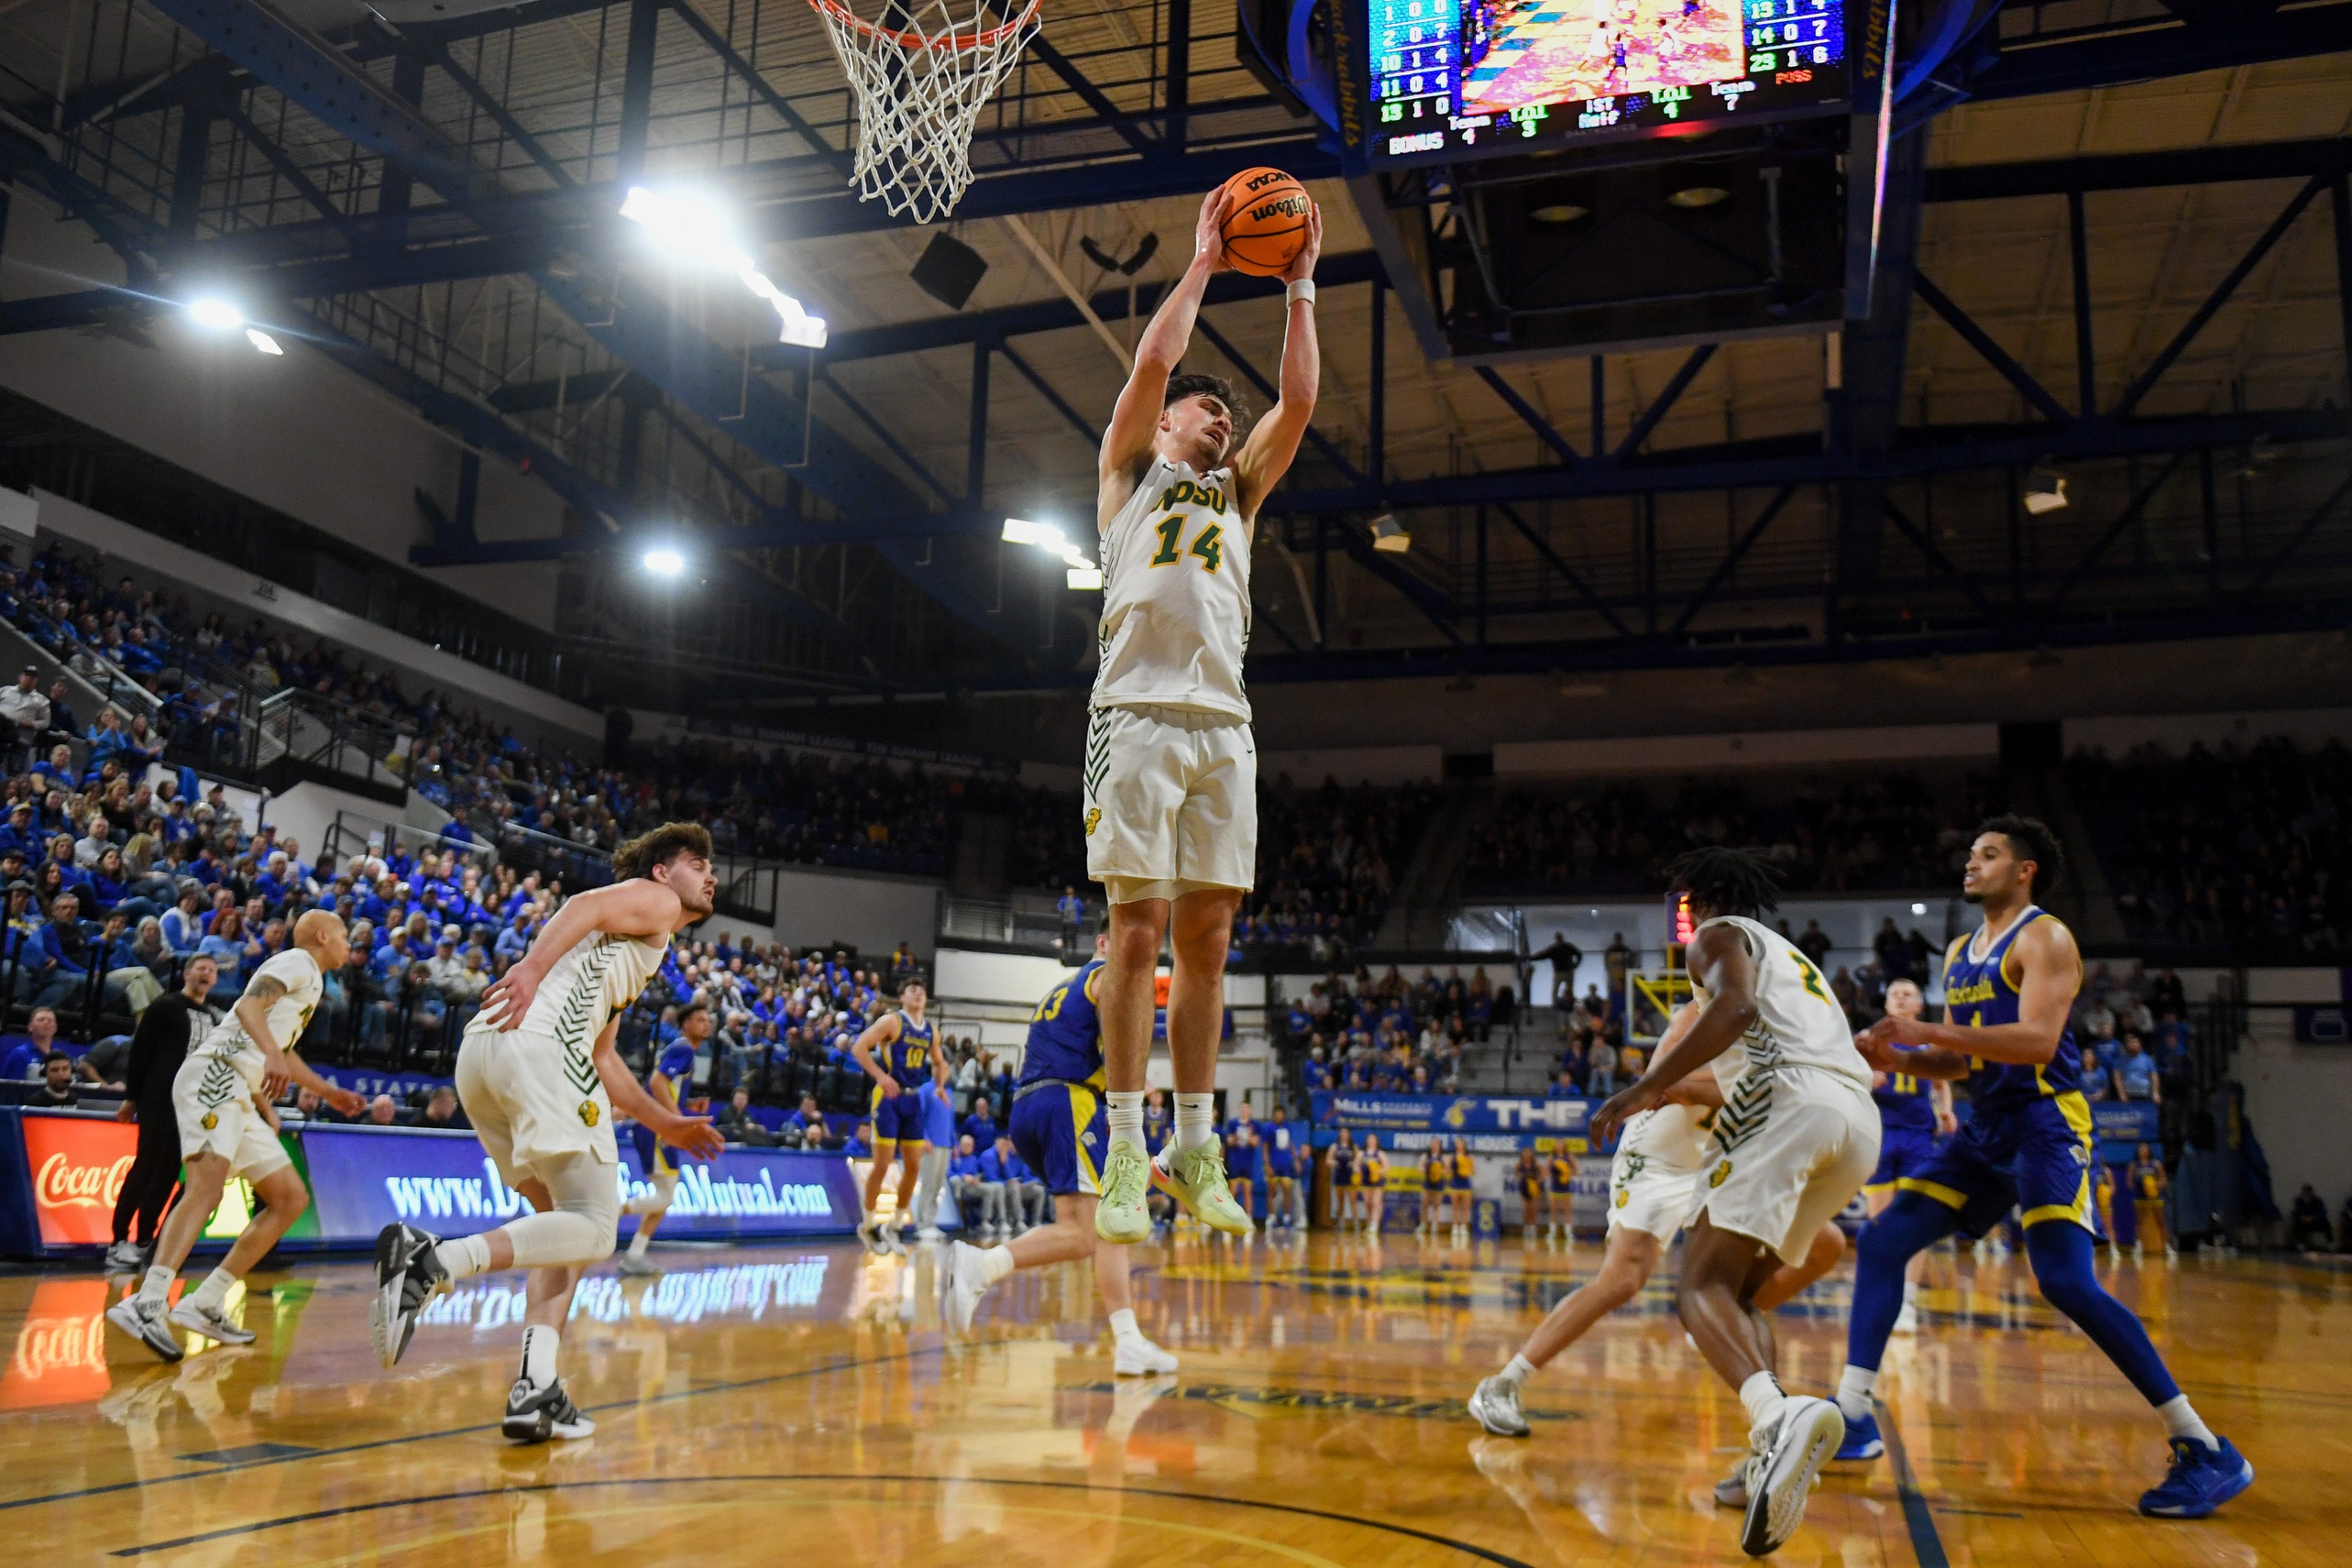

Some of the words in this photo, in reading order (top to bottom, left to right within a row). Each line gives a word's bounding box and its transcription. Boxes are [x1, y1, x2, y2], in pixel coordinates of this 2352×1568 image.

[1384, 5, 1393, 21] 1
[1409, 1, 1421, 17] 0
[1434, 0, 1446, 14] 0
[1751, 1, 1774, 19] 13
[1382, 29, 1396, 47] 2
[1409, 26, 1422, 43] 0
[1434, 22, 1447, 38] 7
[1752, 27, 1775, 46] 14
[1784, 23, 1798, 41] 0
[1812, 19, 1828, 37] 7
[1380, 54, 1401, 72] 10
[1412, 51, 1421, 68] 1
[1434, 48, 1447, 63] 4
[1749, 52, 1776, 72] 23
[1787, 49, 1798, 68] 1
[1813, 46, 1829, 64] 6
[1380, 79, 1401, 97] 11
[1410, 75, 1423, 93] 0
[1435, 72, 1448, 88] 4
[1709, 80, 1756, 96] Team
[1775, 70, 1813, 84] POSS
[1381, 104, 1402, 122] 13
[1412, 101, 1423, 117] 1
[1435, 96, 1449, 115] 0
[1664, 102, 1678, 118] 4
[1724, 93, 1740, 111] 7
[1447, 115, 1491, 130] Team
[1522, 120, 1536, 137] 3
[1389, 131, 1444, 155] BONUS
[1462, 128, 1476, 145] 4
[1250, 195, 1311, 222] Wilson
[1149, 479, 1226, 516] NDSU
[1149, 513, 1225, 575] 14
[1788, 950, 1831, 1005] 2
[906, 1047, 925, 1069] 10
